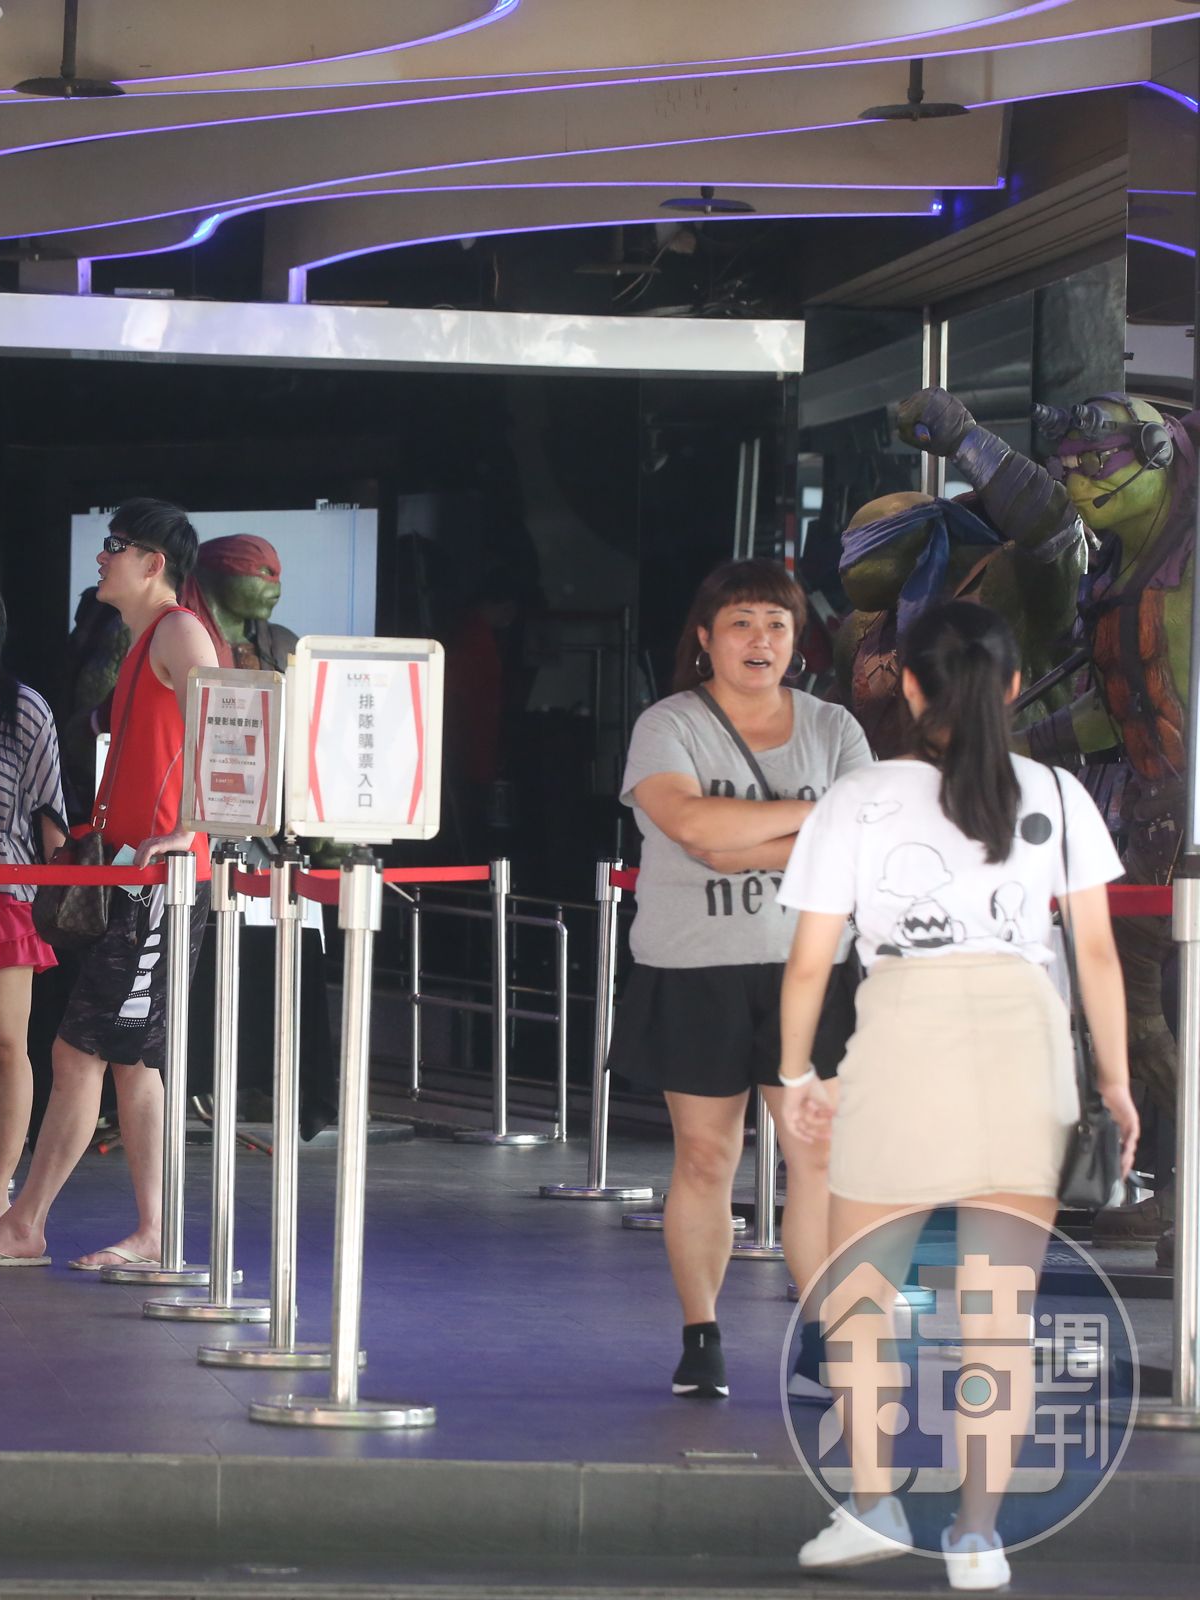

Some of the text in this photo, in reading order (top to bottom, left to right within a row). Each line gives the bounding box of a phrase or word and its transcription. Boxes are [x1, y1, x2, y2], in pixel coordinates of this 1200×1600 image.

[347, 673, 370, 681] LUX
[358, 694, 374, 808] 排隊購票入口
